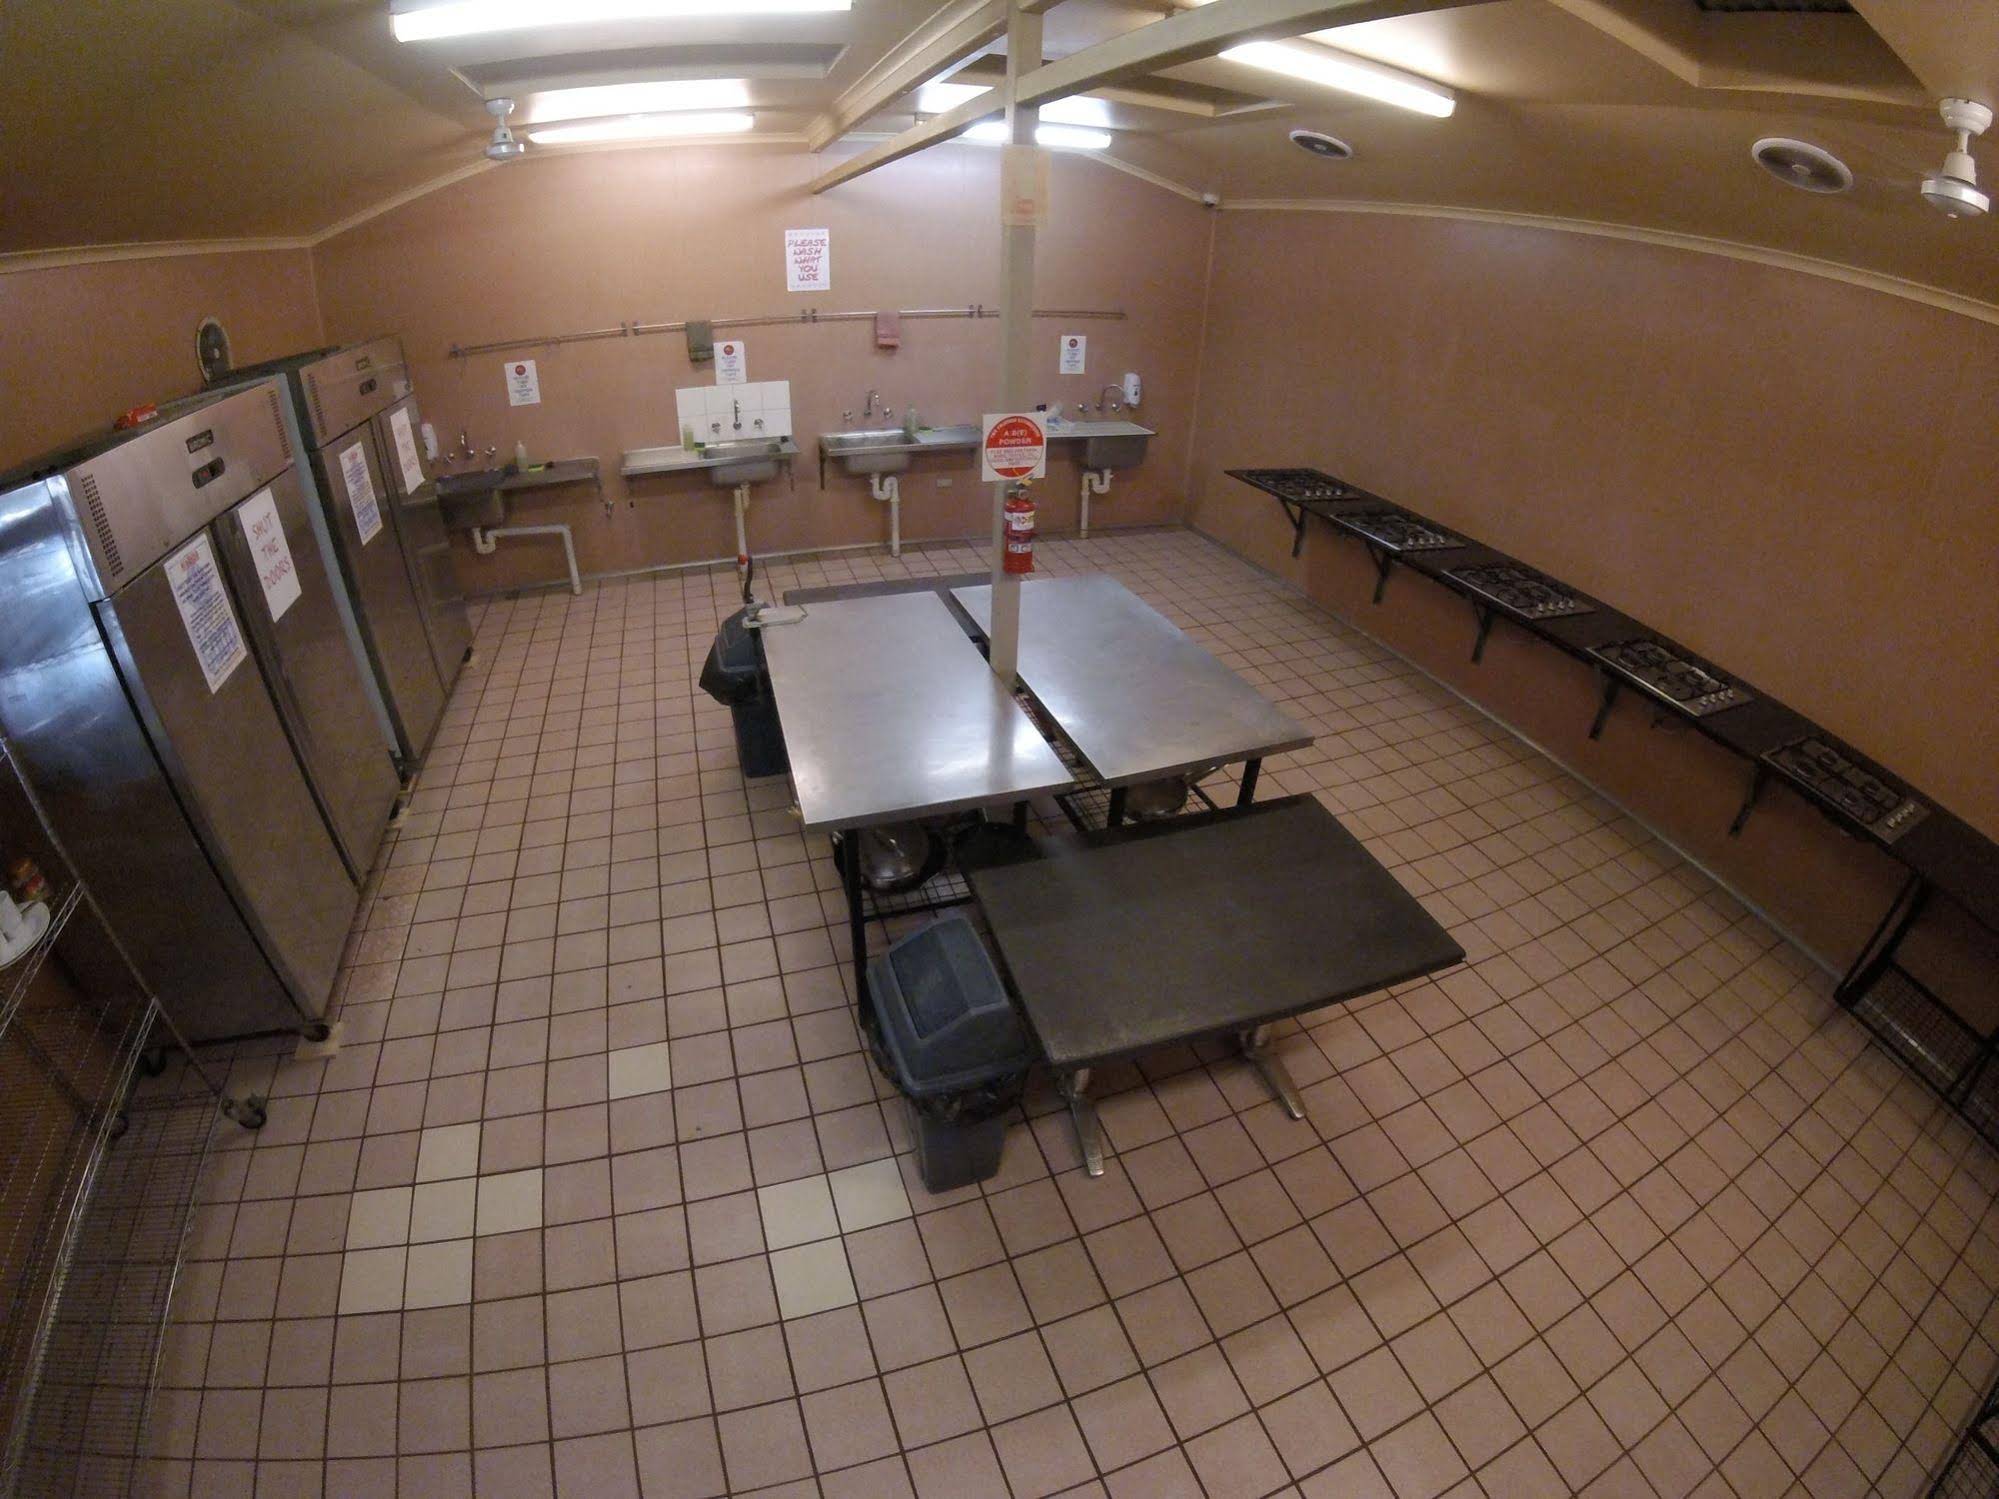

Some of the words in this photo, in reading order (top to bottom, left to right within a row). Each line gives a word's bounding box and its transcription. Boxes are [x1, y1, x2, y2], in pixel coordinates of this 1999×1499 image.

[788, 239, 827, 247] PLEASE
[794, 256, 823, 264] WHAT
[798, 273, 819, 281] USE
[998, 437, 1032, 446] POWDER
